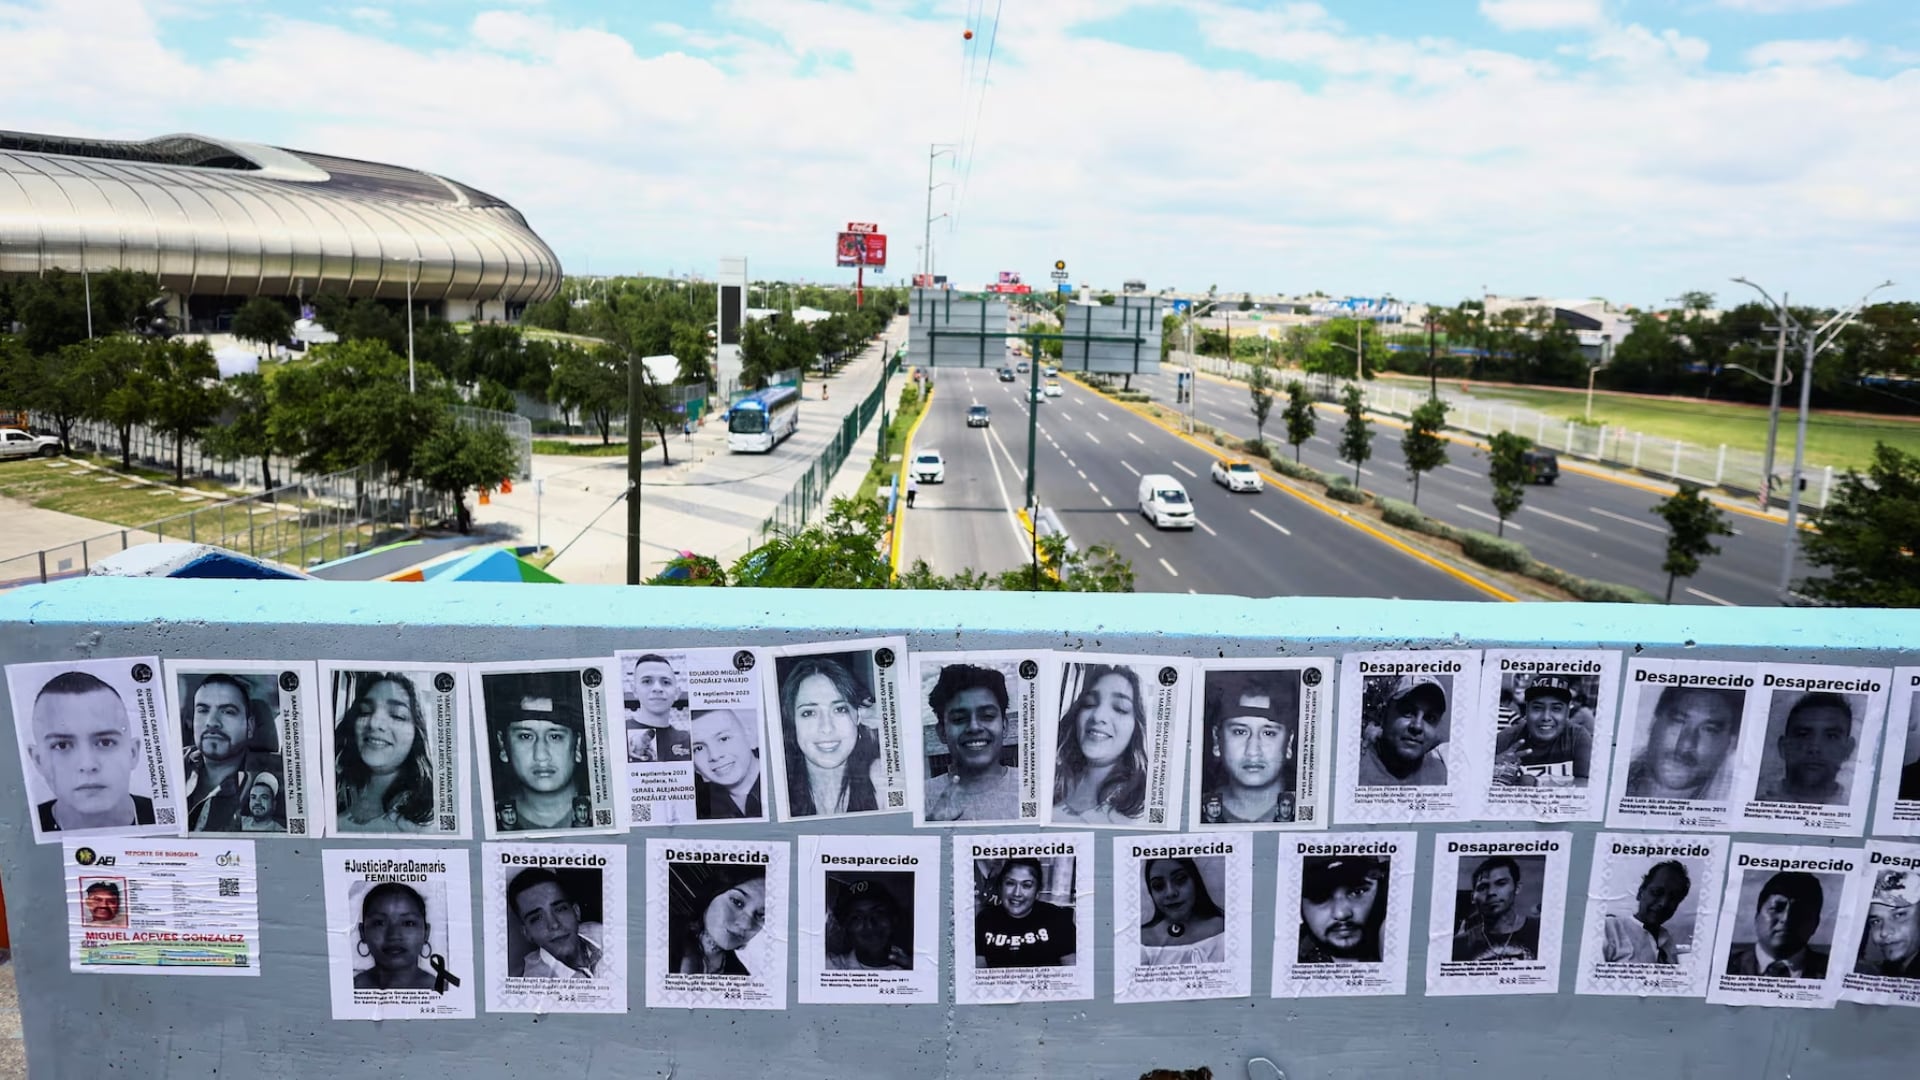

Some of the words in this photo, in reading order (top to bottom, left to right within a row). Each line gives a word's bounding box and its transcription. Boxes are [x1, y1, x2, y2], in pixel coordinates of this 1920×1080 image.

[1359, 660, 1461, 675] Desaparecido
[1500, 659, 1601, 673] Desaparecido
[1634, 669, 1754, 687] Desaparecido
[1763, 674, 1881, 692] Desaparecido
[136, 688, 144, 697] 04
[436, 695, 442, 703] 15
[146, 688, 155, 718] ROBERTO
[290, 695, 298, 720] RAMÓN
[1164, 688, 1172, 720] YAMILETH
[138, 698, 149, 736] SEPTIEMBRE
[150, 719, 160, 744] CARLOS
[882, 713, 890, 747] CADEREYTA
[144, 738, 152, 753] 2023
[292, 722, 300, 760] GUADALUPE
[1162, 721, 1170, 759] GUADALUPE
[154, 745, 162, 764] MOTA
[294, 762, 302, 791] HERRERA
[972, 842, 1074, 859] Desaparecida
[1132, 842, 1233, 858] Desaparecida
[1297, 841, 1397, 856] Desaparecido
[1448, 840, 1559, 854] Desaparecido
[1612, 843, 1710, 857] Desaparecido
[96, 856, 116, 866] AEI
[501, 853, 607, 867] Desaparecido
[666, 849, 769, 863] Desaparecida
[821, 854, 919, 866] Desaparecido
[1738, 854, 1853, 871] Desaparecido
[1870, 851, 1920, 870] Desap
[345, 859, 446, 873] #JusticiaParaDamaris
[365, 874, 427, 882] FEMINICIDIO
[85, 932, 130, 941] MIGUEL
[132, 933, 178, 941] ACEVES
